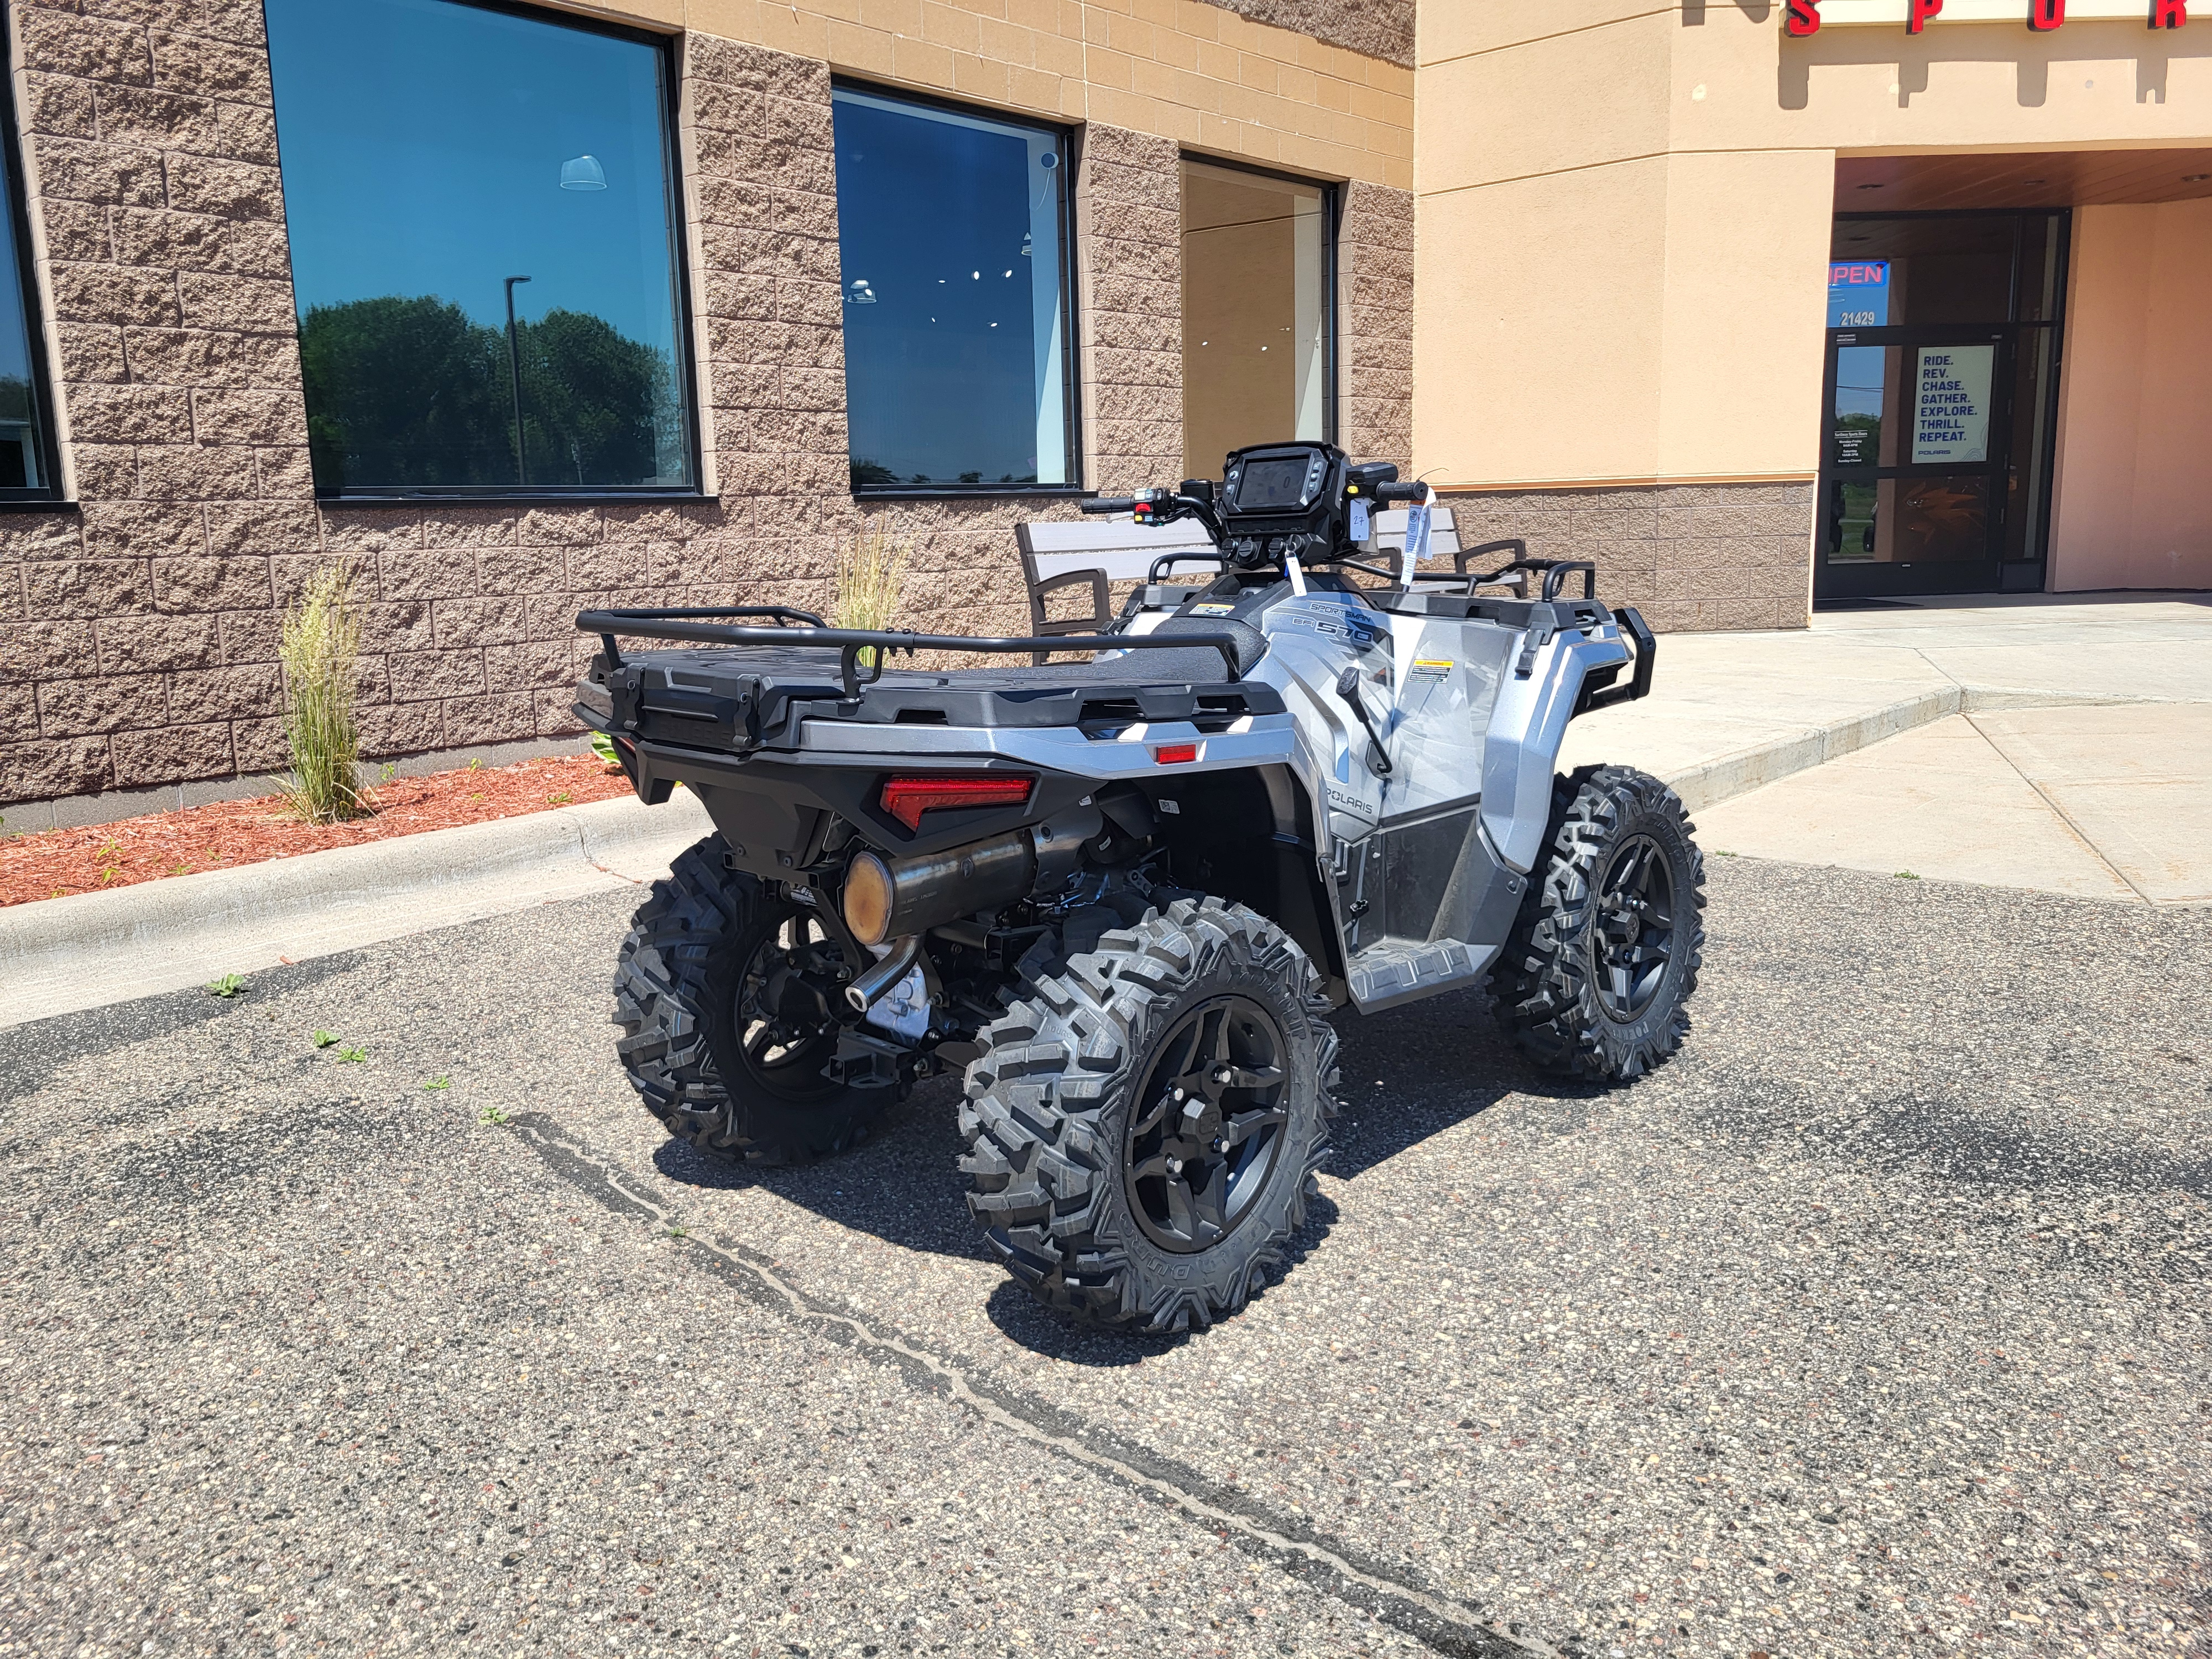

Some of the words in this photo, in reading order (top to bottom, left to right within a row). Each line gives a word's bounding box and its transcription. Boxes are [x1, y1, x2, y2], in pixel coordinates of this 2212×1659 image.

[1840, 311, 1875, 326] 21429
[1923, 355, 1954, 366] RIDE.
[1923, 368, 1949, 379] REV.
[1922, 380, 1964, 392] CHASE.
[1921, 393, 1971, 404] GATHER.
[1920, 405, 1978, 417] EXPLORE.
[1919, 419, 1965, 430] THRILL.
[1918, 431, 1966, 442] REPEAT.
[1353, 515, 1365, 526] 27
[1310, 603, 1371, 622] SPORTSMAN
[1293, 618, 1314, 627] EFI
[1315, 621, 1373, 643] 570
[1327, 787, 1373, 815] POLARIS
